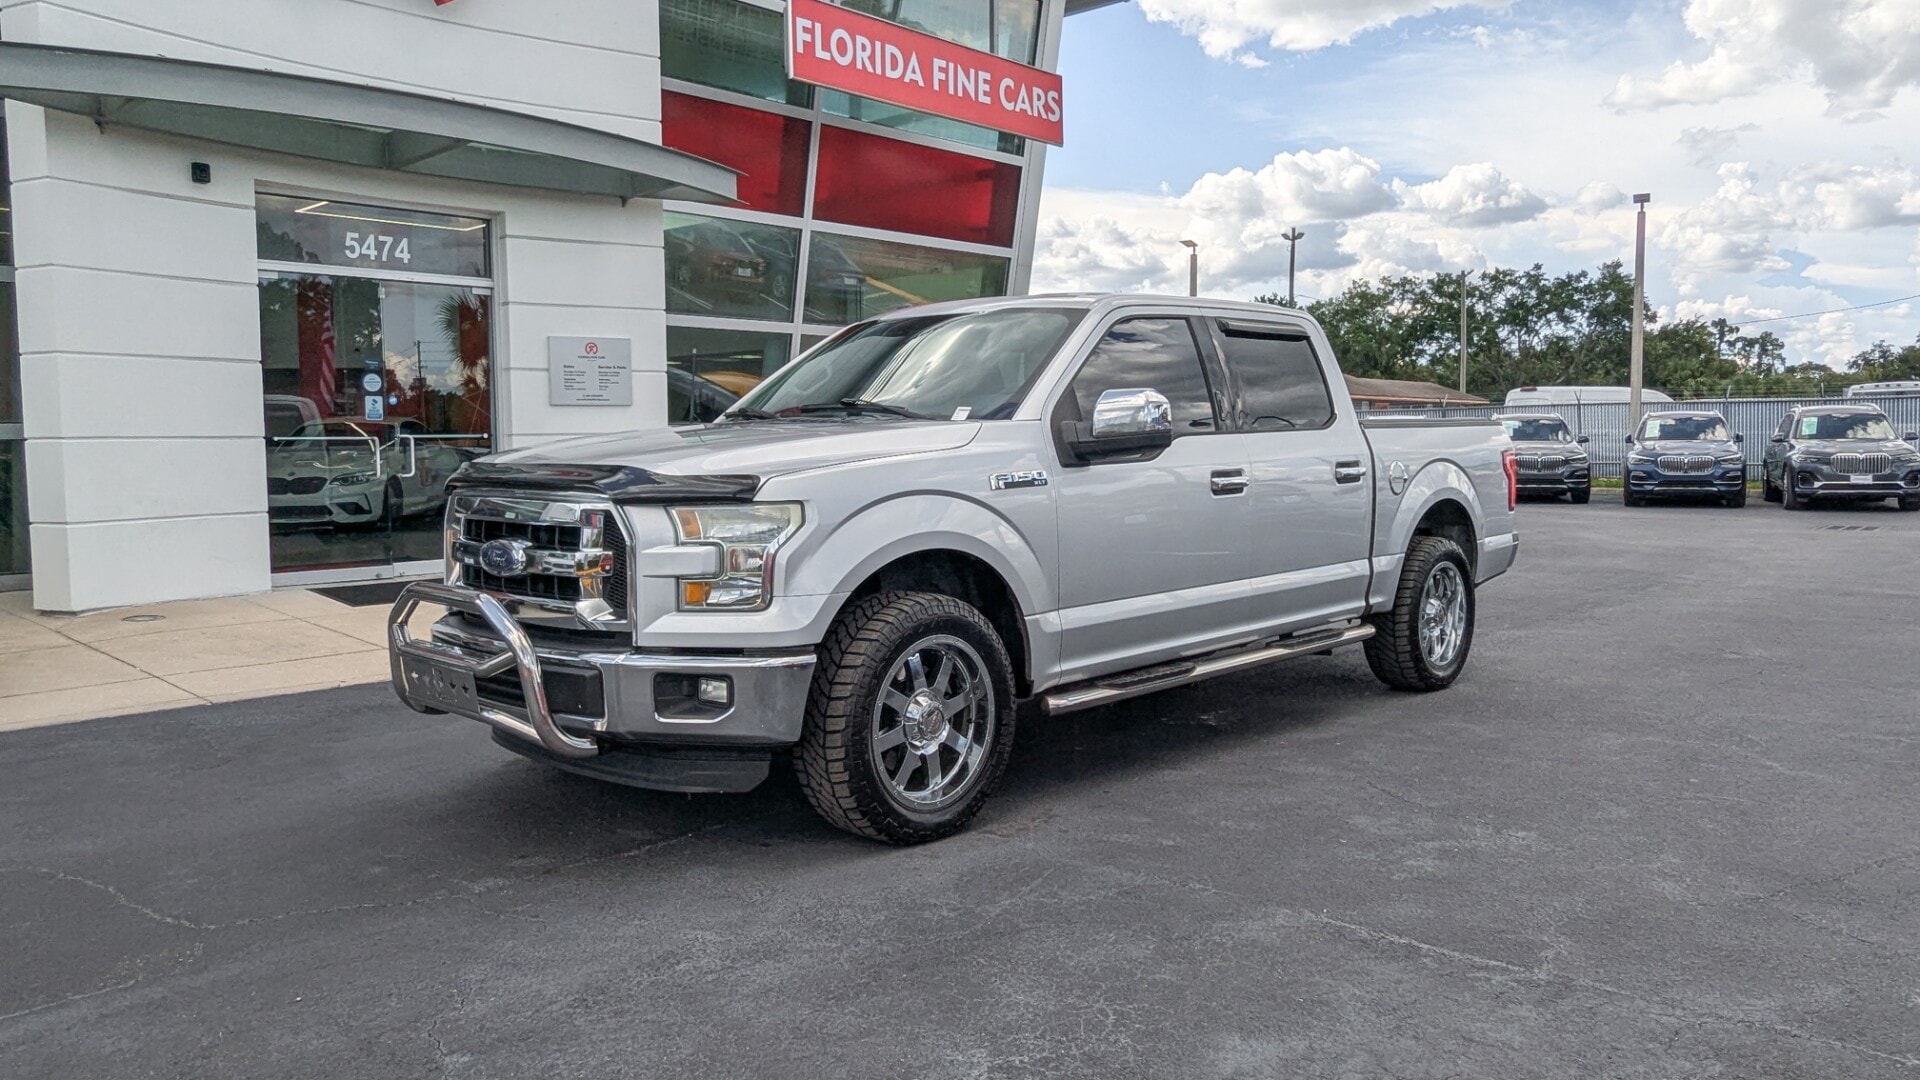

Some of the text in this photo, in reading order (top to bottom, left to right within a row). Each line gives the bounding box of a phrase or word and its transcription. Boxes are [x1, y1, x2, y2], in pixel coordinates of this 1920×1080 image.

[796, 16, 1061, 122] FLORIDA FINE CARS
[345, 231, 411, 263] 5474
